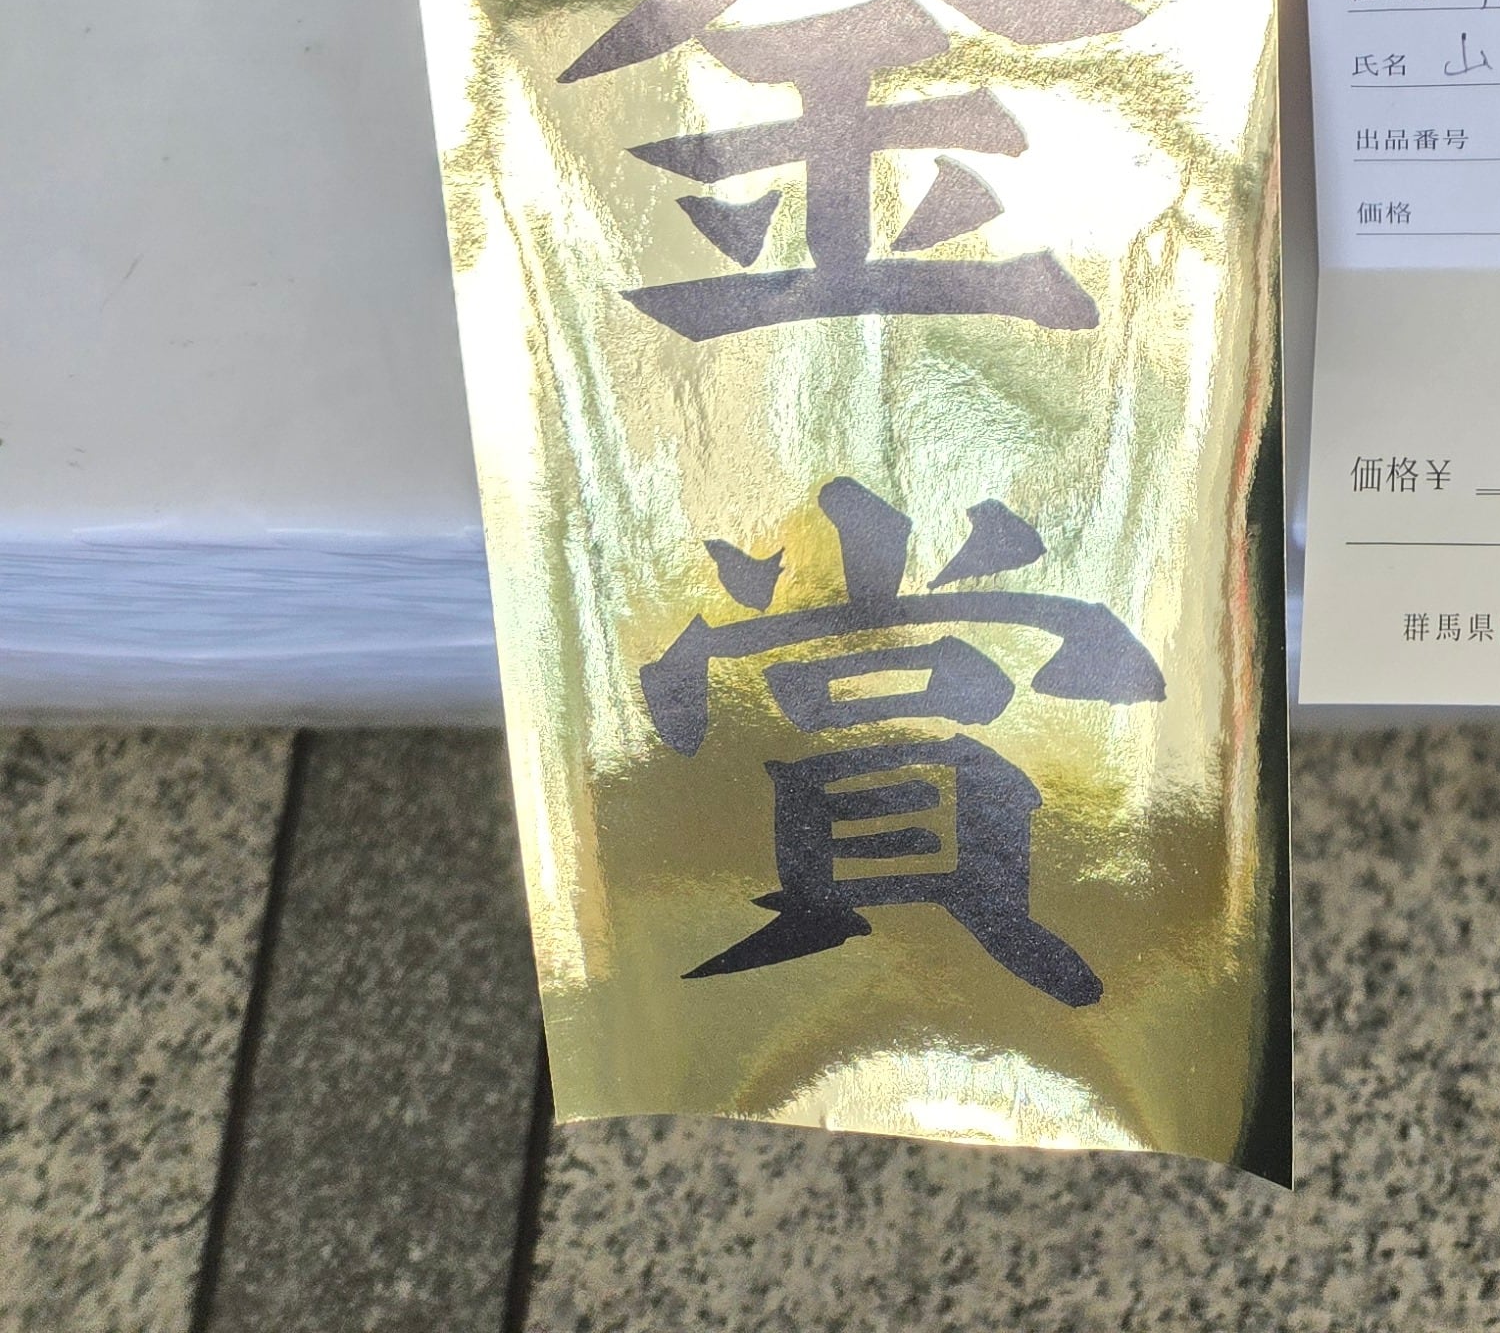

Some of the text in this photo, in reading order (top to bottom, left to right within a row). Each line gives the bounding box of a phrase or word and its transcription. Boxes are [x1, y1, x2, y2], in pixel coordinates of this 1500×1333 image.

[1352, 54, 1406, 77] 氏名
[1356, 128, 1469, 151] 出品番号
[1358, 201, 1412, 225] 価格
